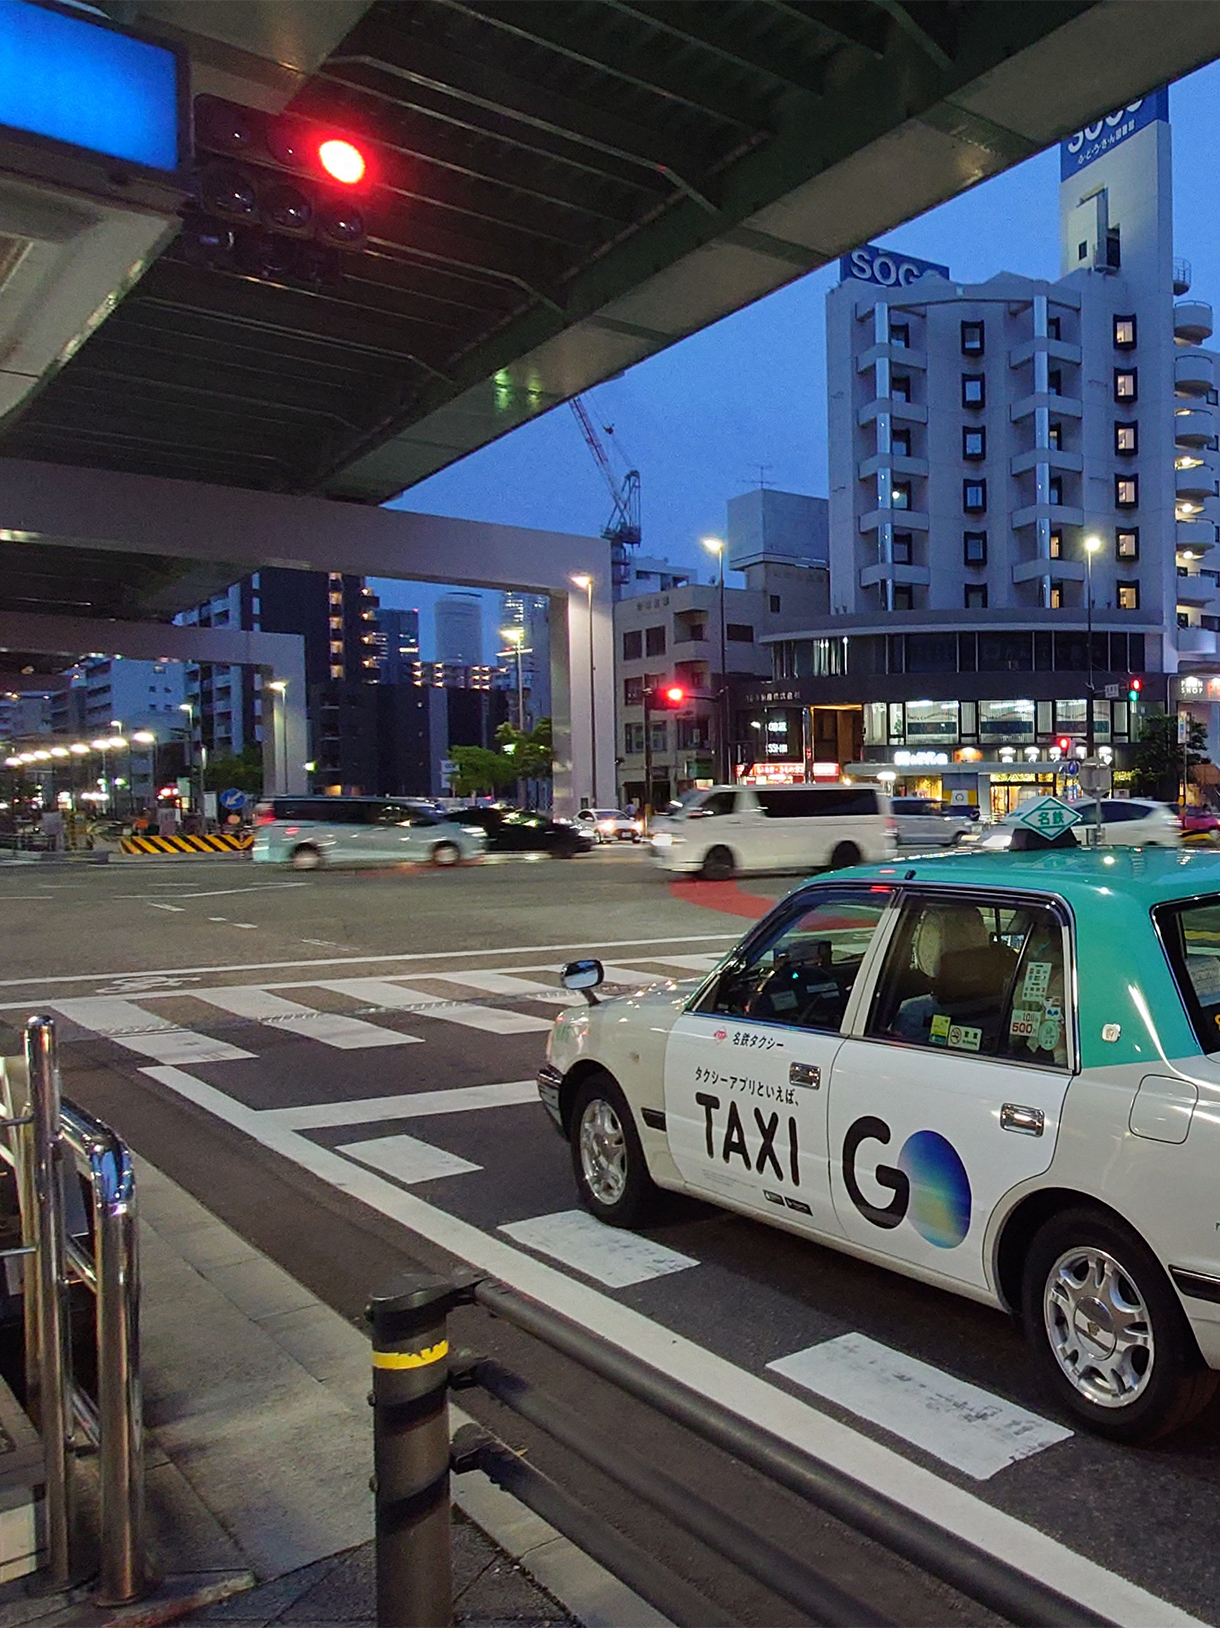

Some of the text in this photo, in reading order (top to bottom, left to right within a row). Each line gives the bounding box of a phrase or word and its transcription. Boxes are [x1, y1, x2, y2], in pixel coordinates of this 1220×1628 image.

[1037, 810, 1065, 825] 名鉄
[732, 1030, 785, 1051] 名鉄タクシー
[694, 1066, 800, 1107] タクシーアプリといえば、
[695, 1092, 800, 1187] TAXI
